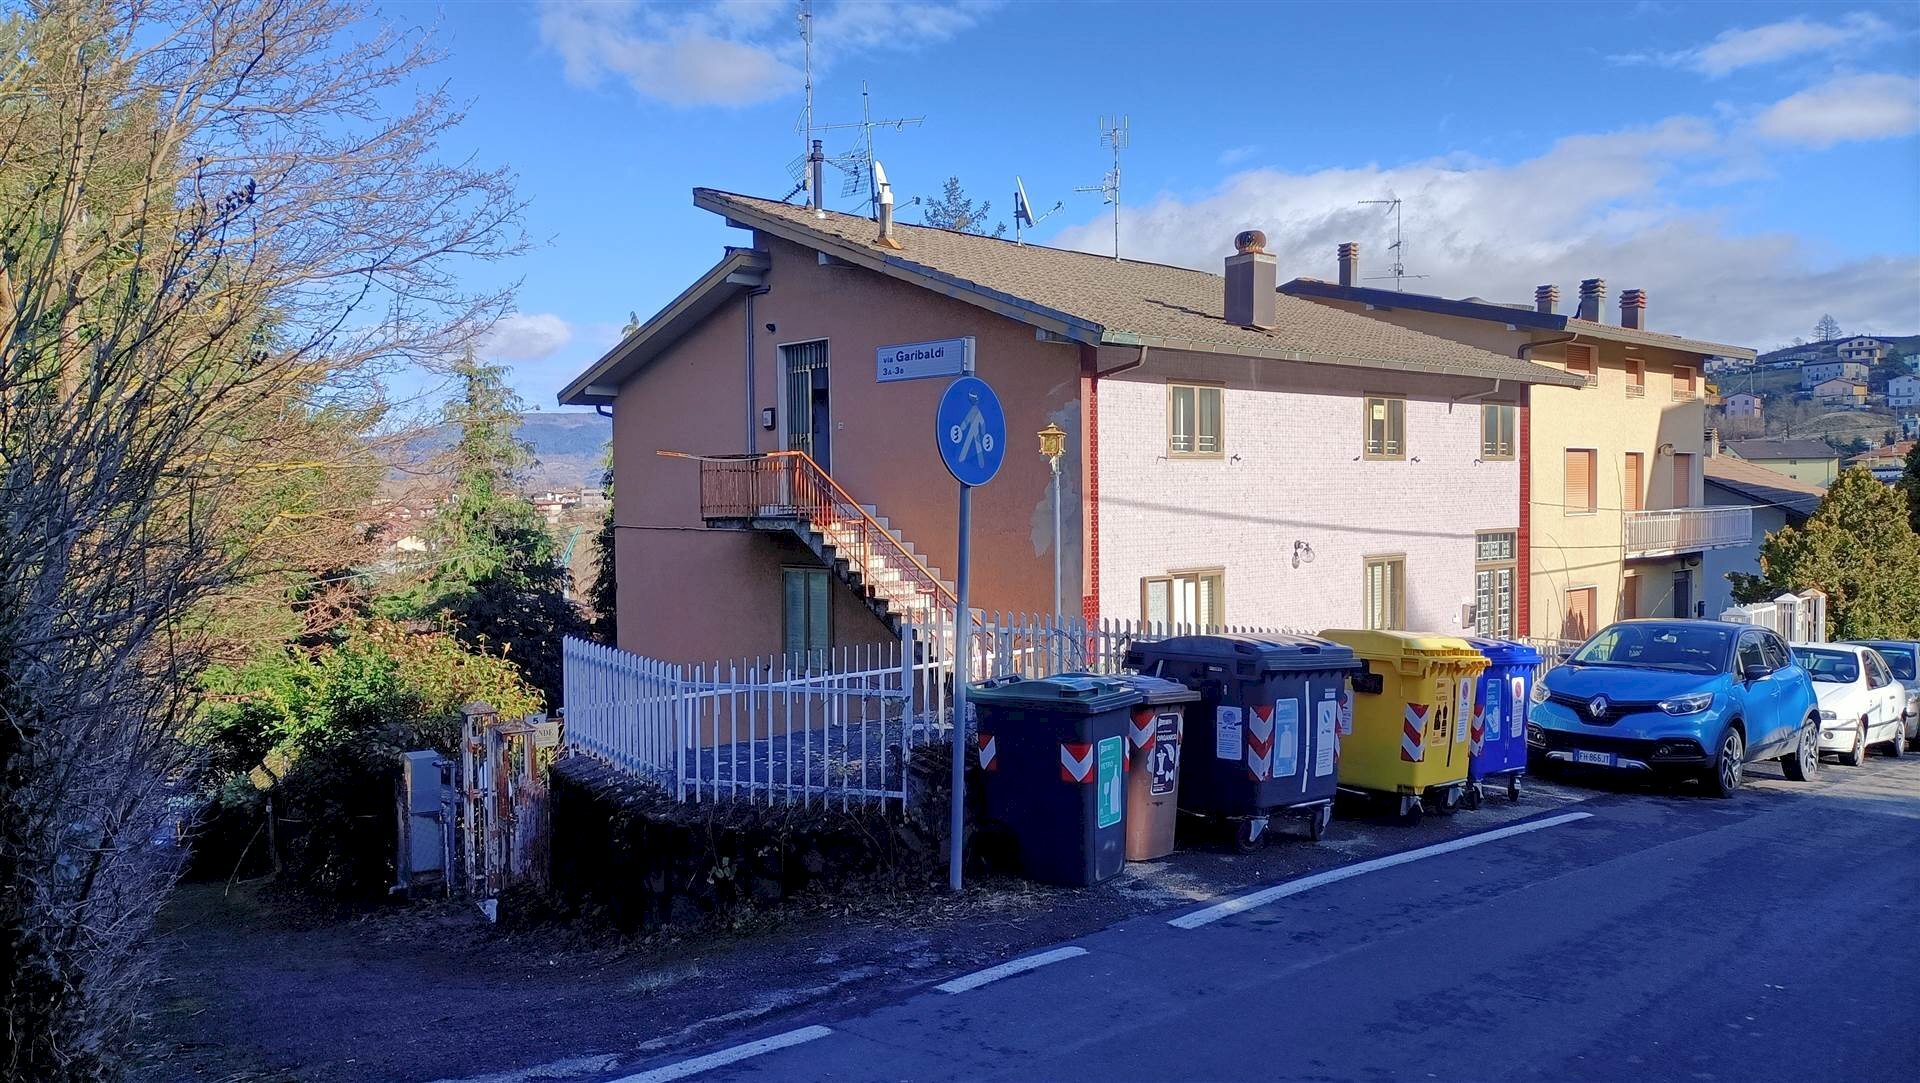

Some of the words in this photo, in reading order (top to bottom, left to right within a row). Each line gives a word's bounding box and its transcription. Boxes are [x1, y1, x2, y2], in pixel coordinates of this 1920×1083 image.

[883, 356, 893, 364] via
[896, 346, 944, 362] Garibaldi
[532, 717, 539, 725] 5
